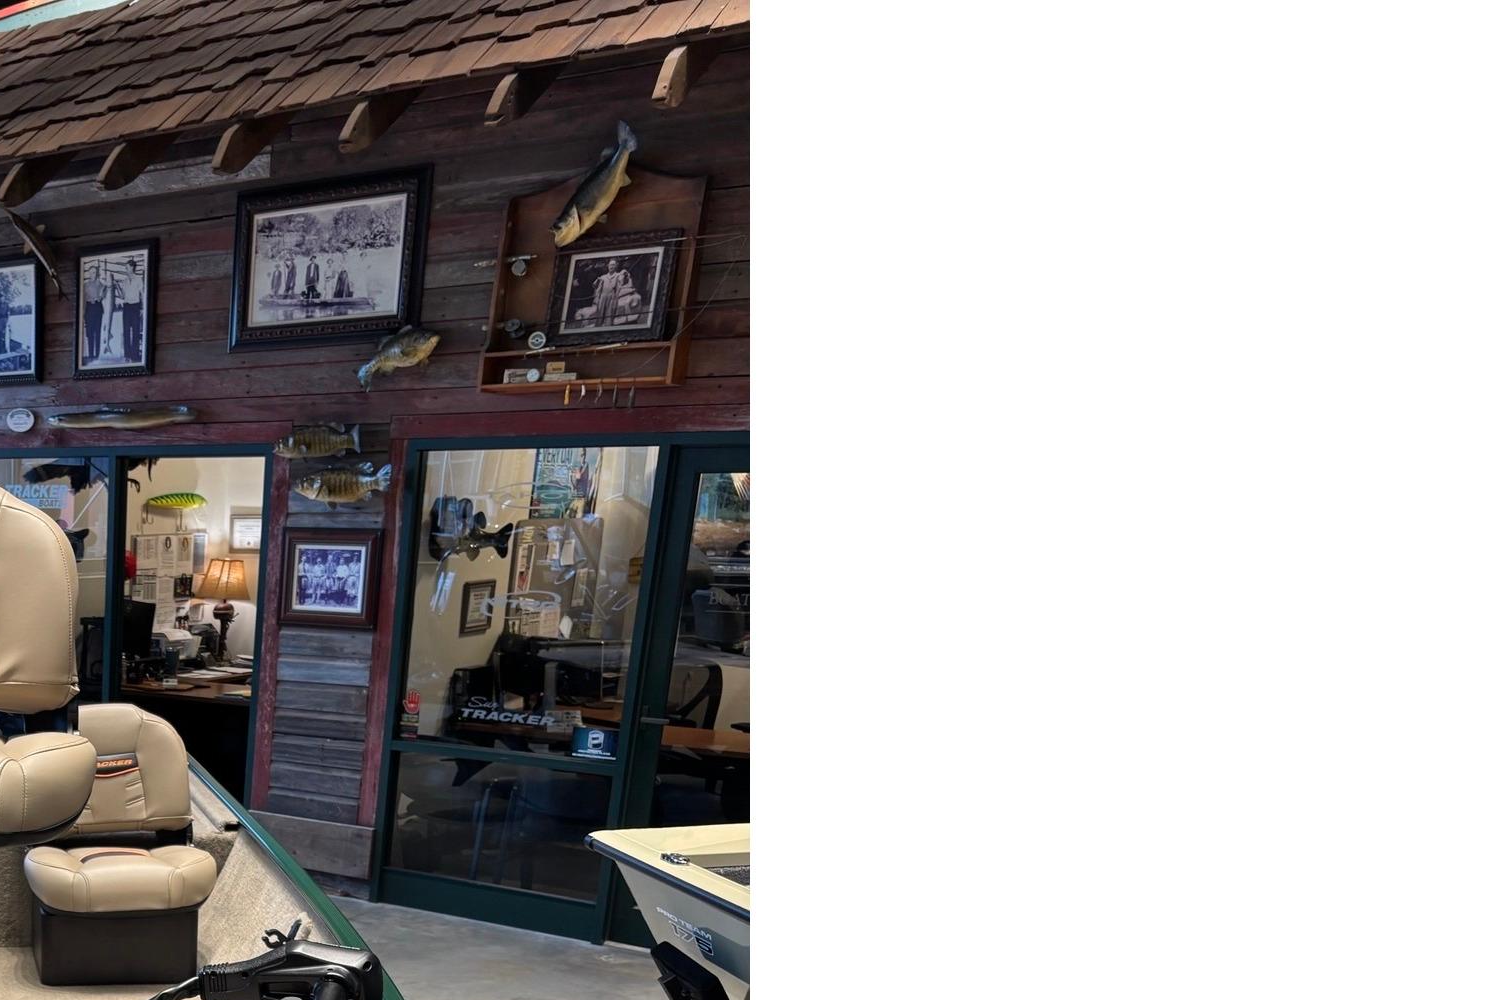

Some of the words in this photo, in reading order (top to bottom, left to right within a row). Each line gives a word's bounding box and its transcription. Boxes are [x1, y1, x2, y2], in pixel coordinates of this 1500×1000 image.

[5, 484, 69, 498] TRACKER
[461, 708, 555, 726] TRACKER
[668, 920, 714, 956] 175
[679, 919, 712, 940] TEAM
